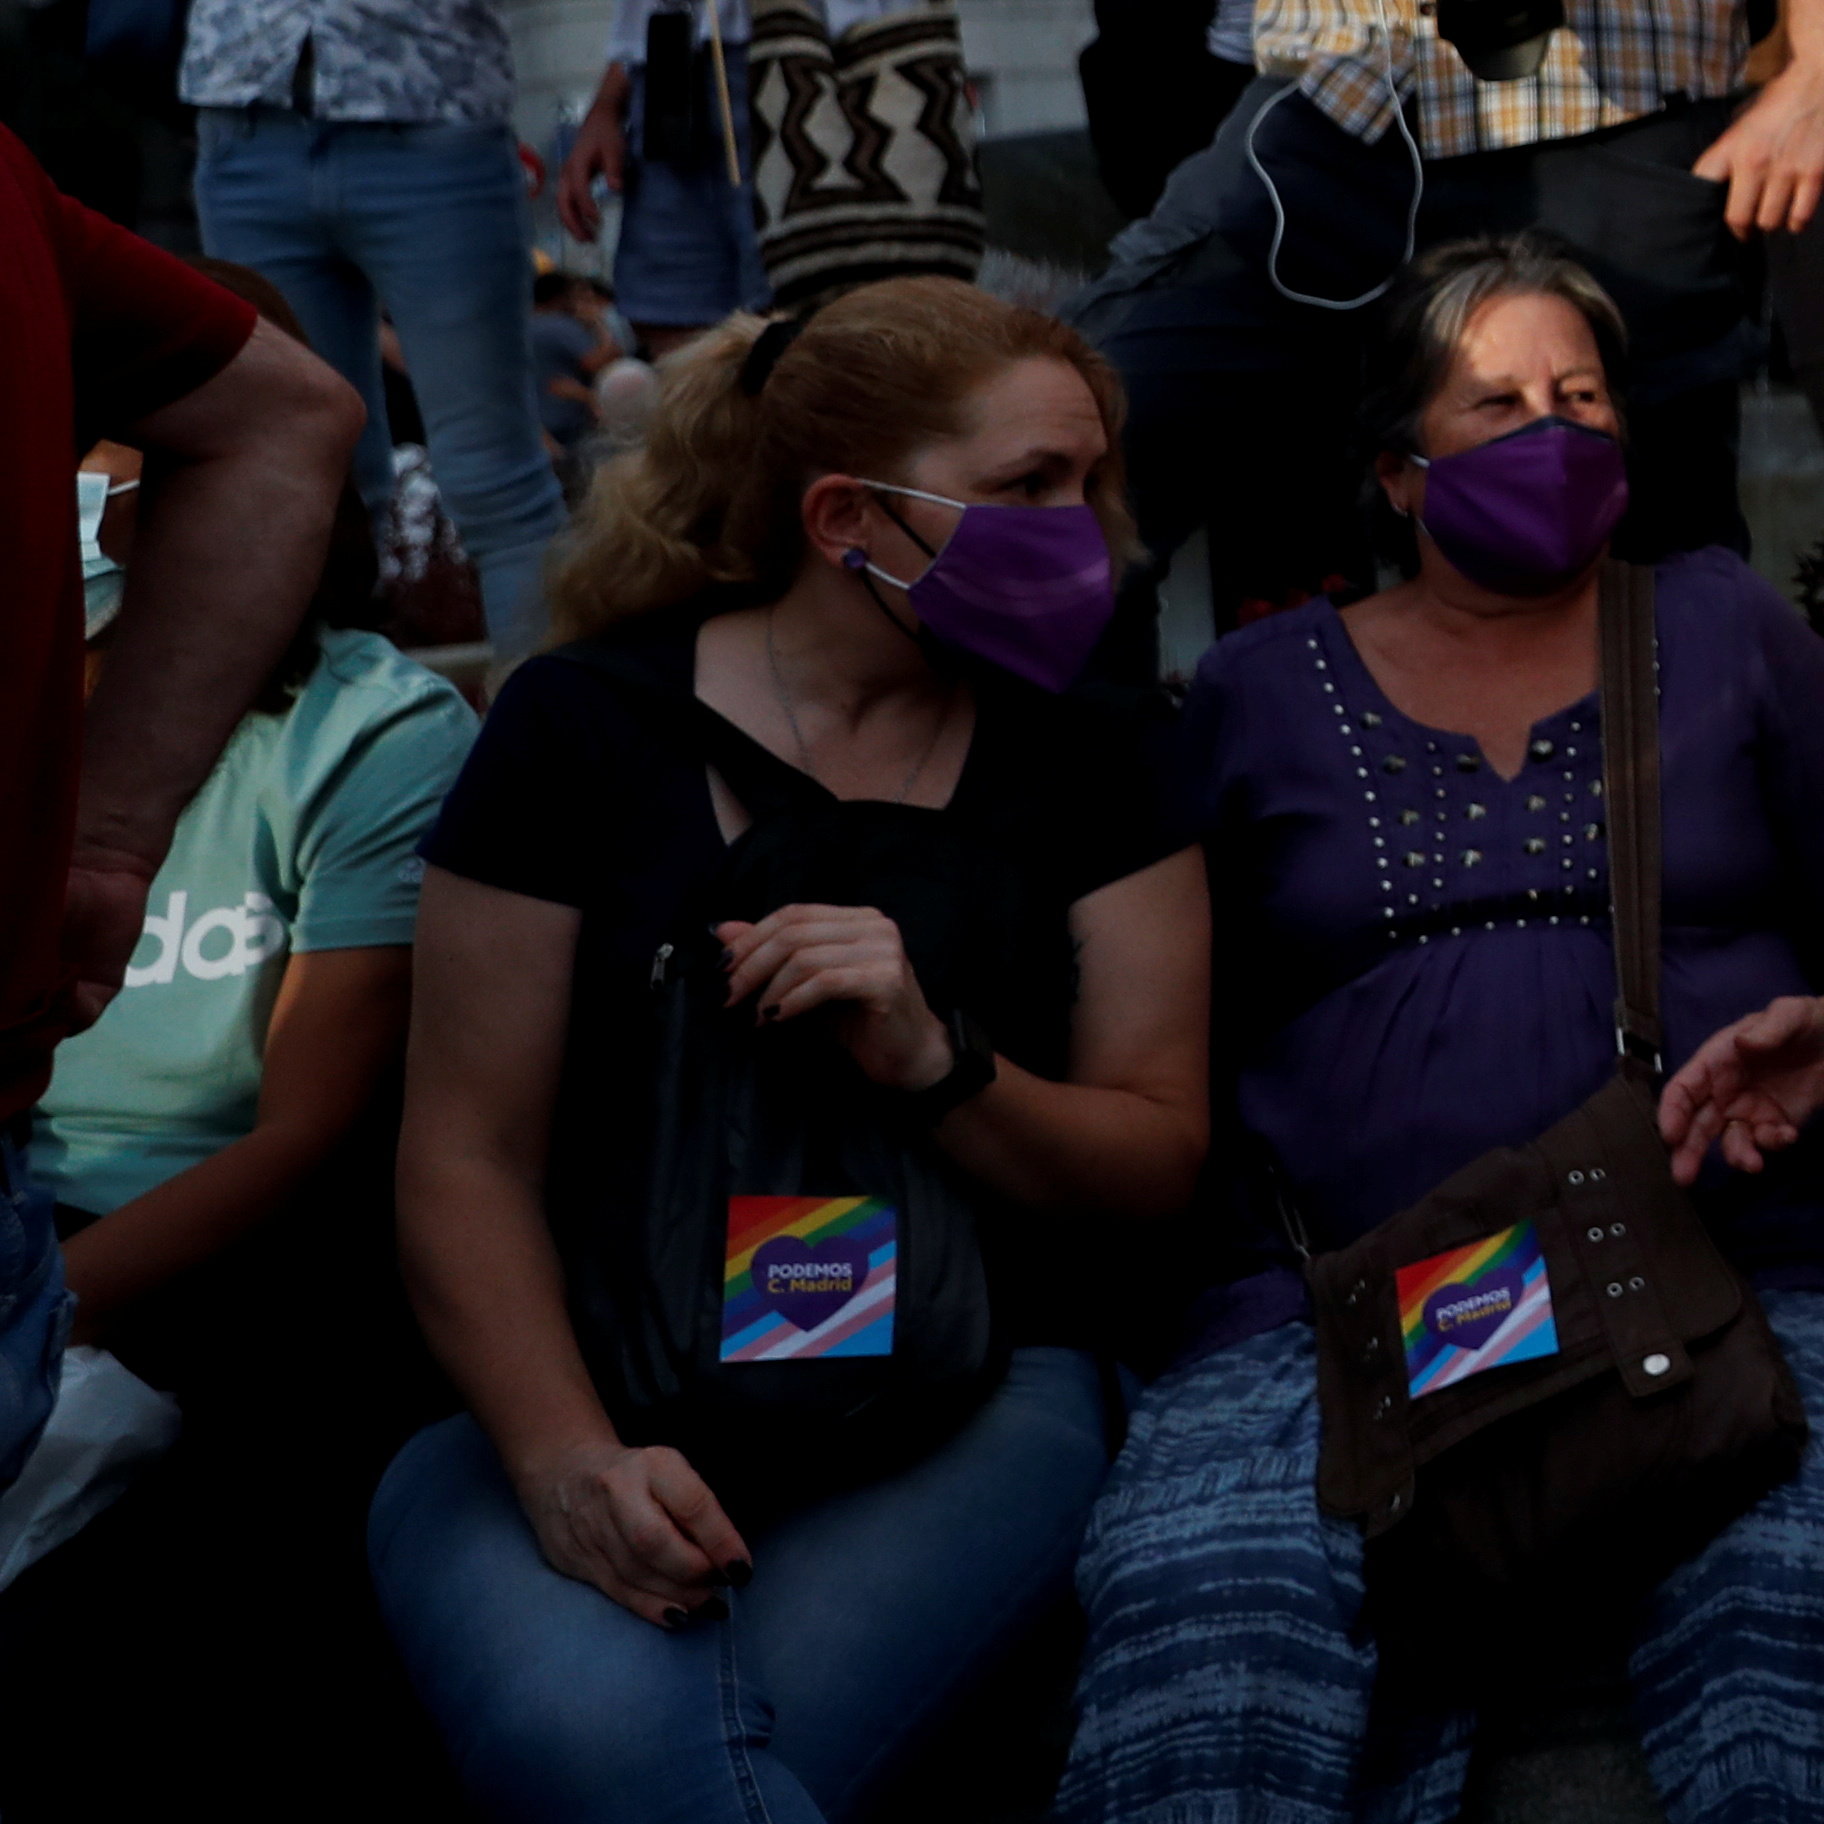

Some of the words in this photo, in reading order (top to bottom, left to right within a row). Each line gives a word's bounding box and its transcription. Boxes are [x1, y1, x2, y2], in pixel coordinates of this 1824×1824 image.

[769, 1263, 852, 1278] PODEMOS
[768, 1279, 784, 1293] C.
[790, 1278, 852, 1292] Madrid
[1436, 1287, 1511, 1320] PODEMOS
